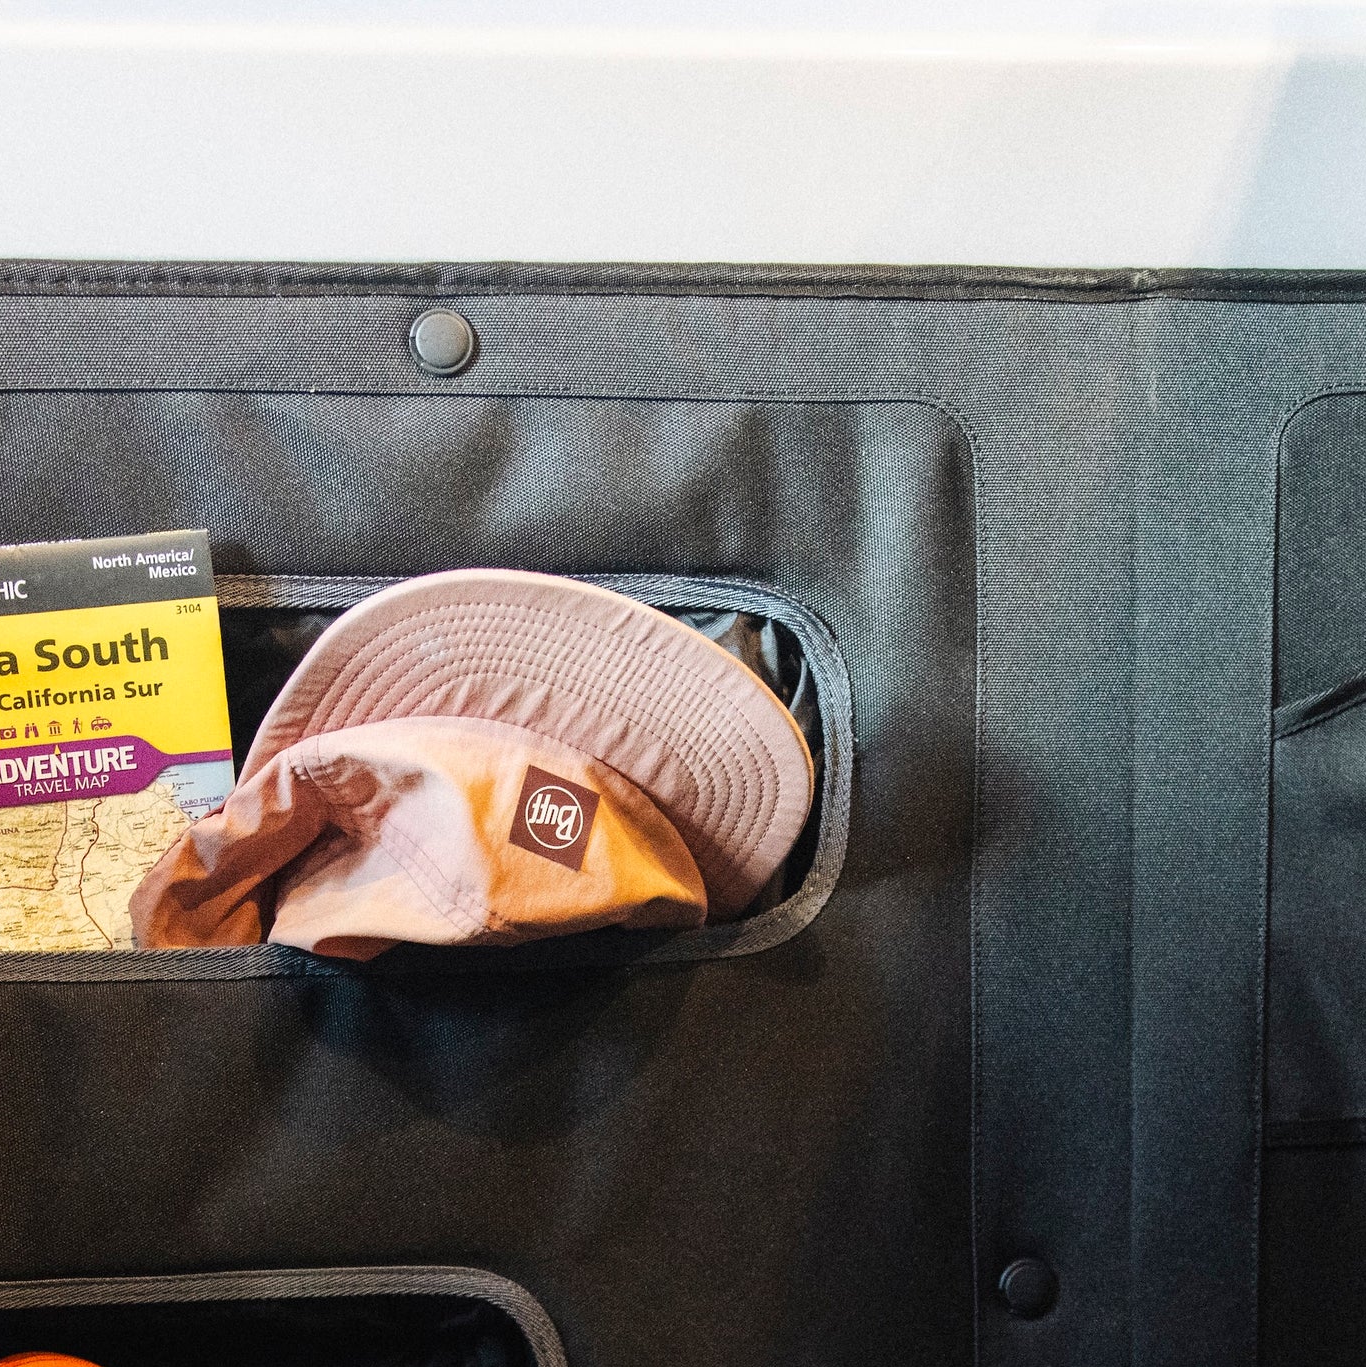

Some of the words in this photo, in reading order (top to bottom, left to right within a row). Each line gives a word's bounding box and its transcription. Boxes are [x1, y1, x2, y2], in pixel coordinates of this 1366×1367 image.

[92, 553, 132, 570] North
[135, 548, 195, 566] America/
[148, 563, 197, 579] Mexico
[175, 603, 202, 615] 3104
[33, 627, 170, 673] South
[123, 680, 164, 699] Sur
[14, 781, 72, 798] TRAVEL
[74, 774, 110, 791] MAP
[179, 798, 199, 807] CABO
